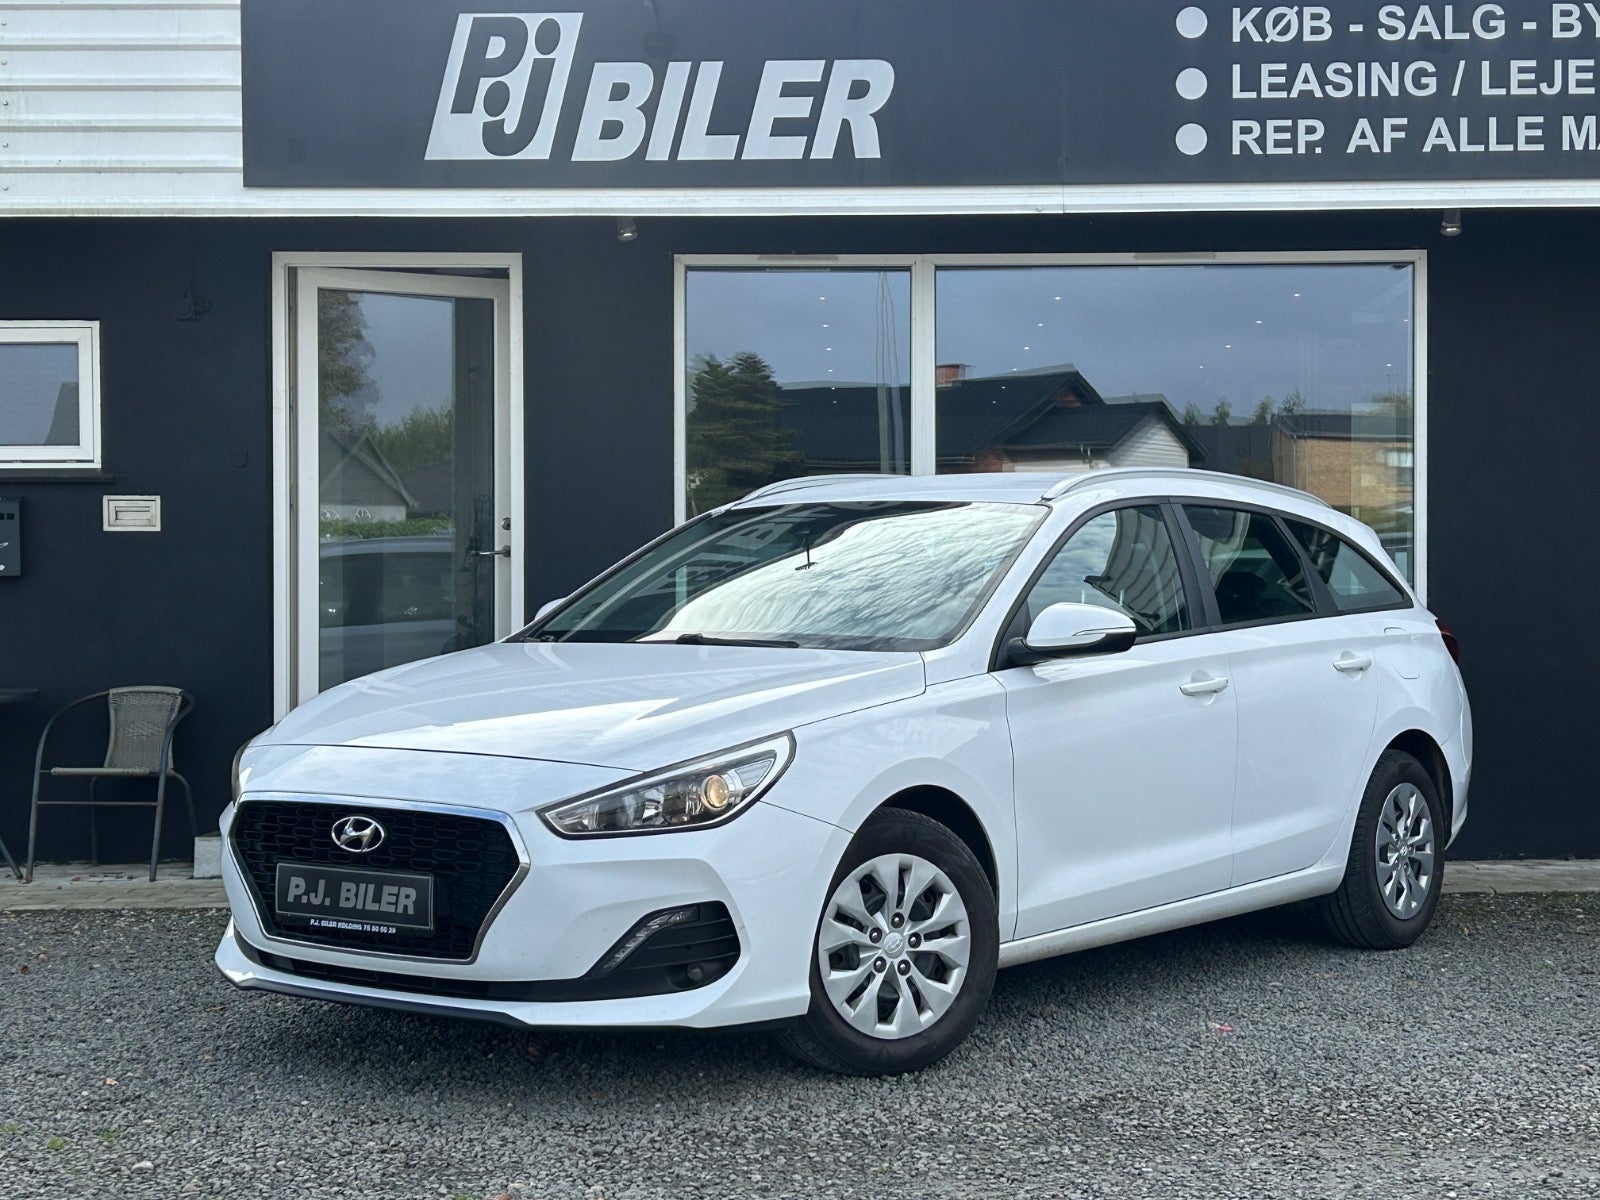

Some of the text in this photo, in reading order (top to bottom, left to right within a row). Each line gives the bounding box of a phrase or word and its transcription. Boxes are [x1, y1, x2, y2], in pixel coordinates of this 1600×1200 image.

[1232, 5, 1333, 43] KØB
[1377, 3, 1506, 41] SALG
[1232, 59, 1596, 99] LEASING / LEJE
[571, 59, 895, 161] BILER
[1231, 115, 1600, 155] REP. AF ALLE M
[287, 876, 417, 915] P.J. BILER
